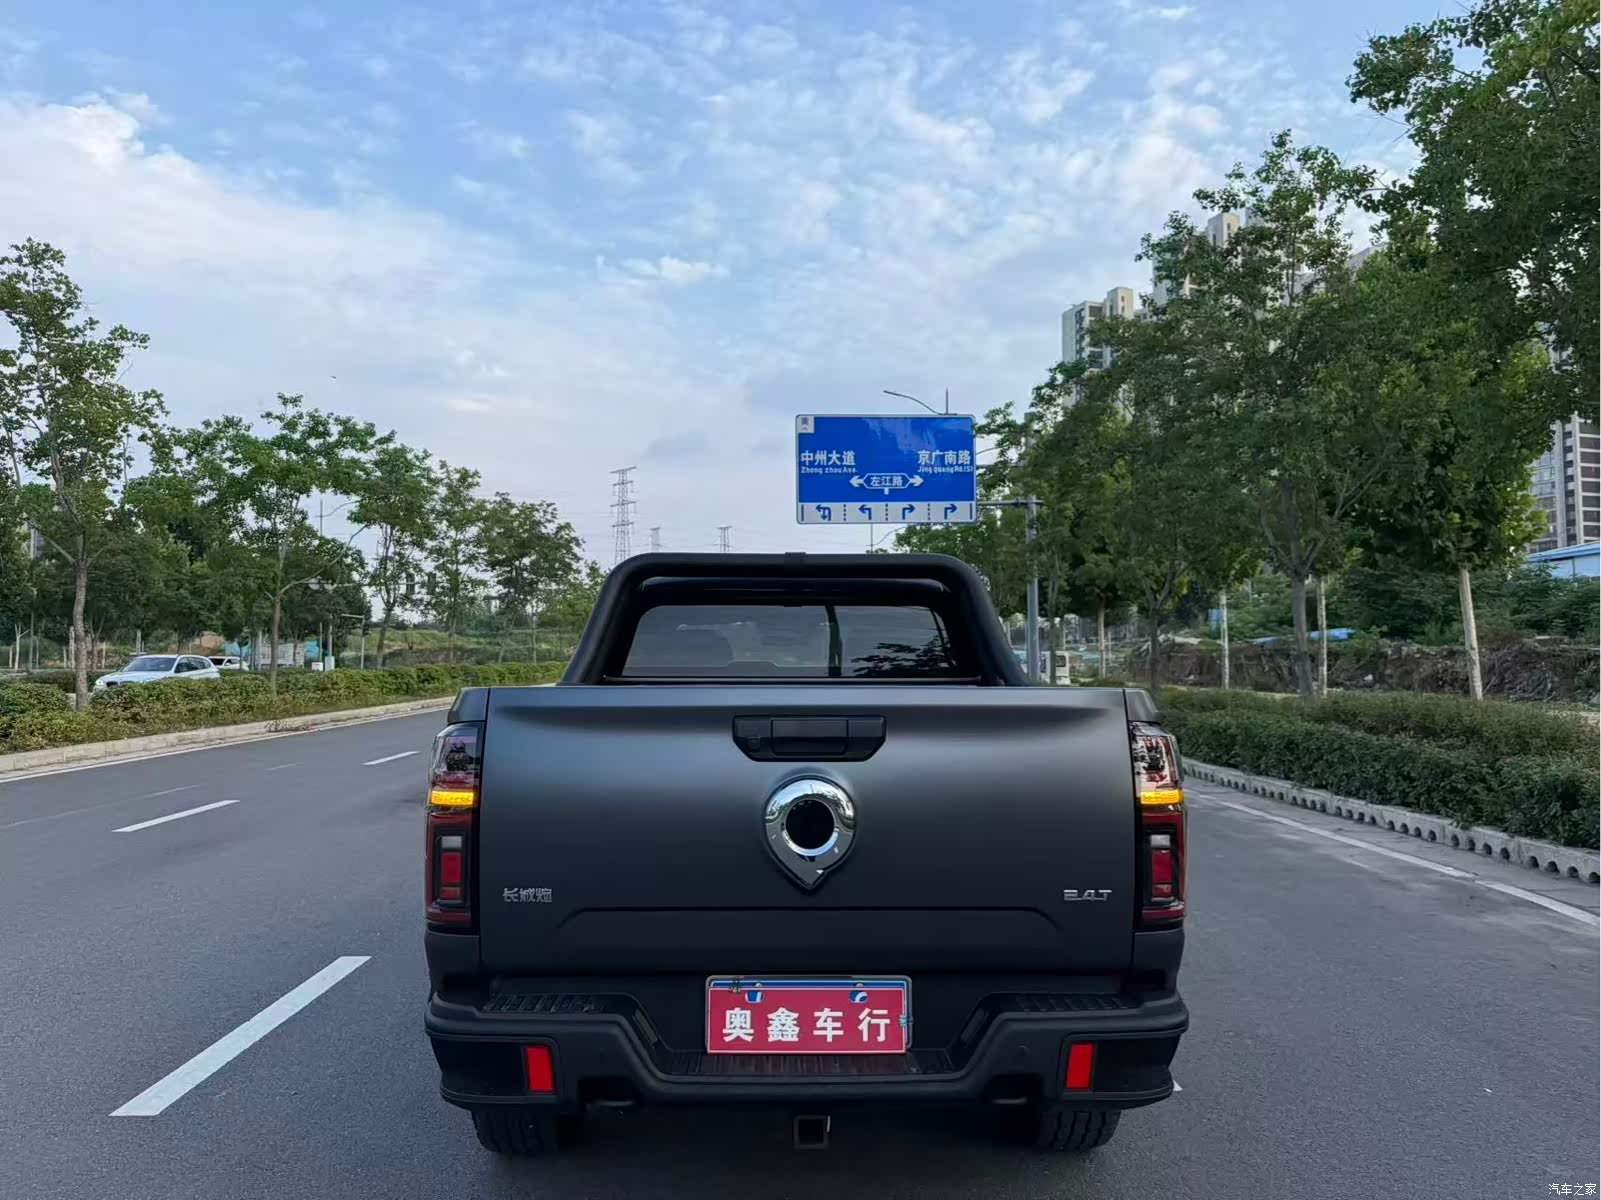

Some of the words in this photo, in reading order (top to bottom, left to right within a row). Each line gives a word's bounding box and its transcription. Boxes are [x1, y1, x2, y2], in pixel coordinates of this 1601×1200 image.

[800, 449, 856, 466] 中州大道
[917, 449, 971, 466] 京广南路
[870, 475, 903, 487] 左江路
[722, 1007, 891, 1043] 奥鑫车行
